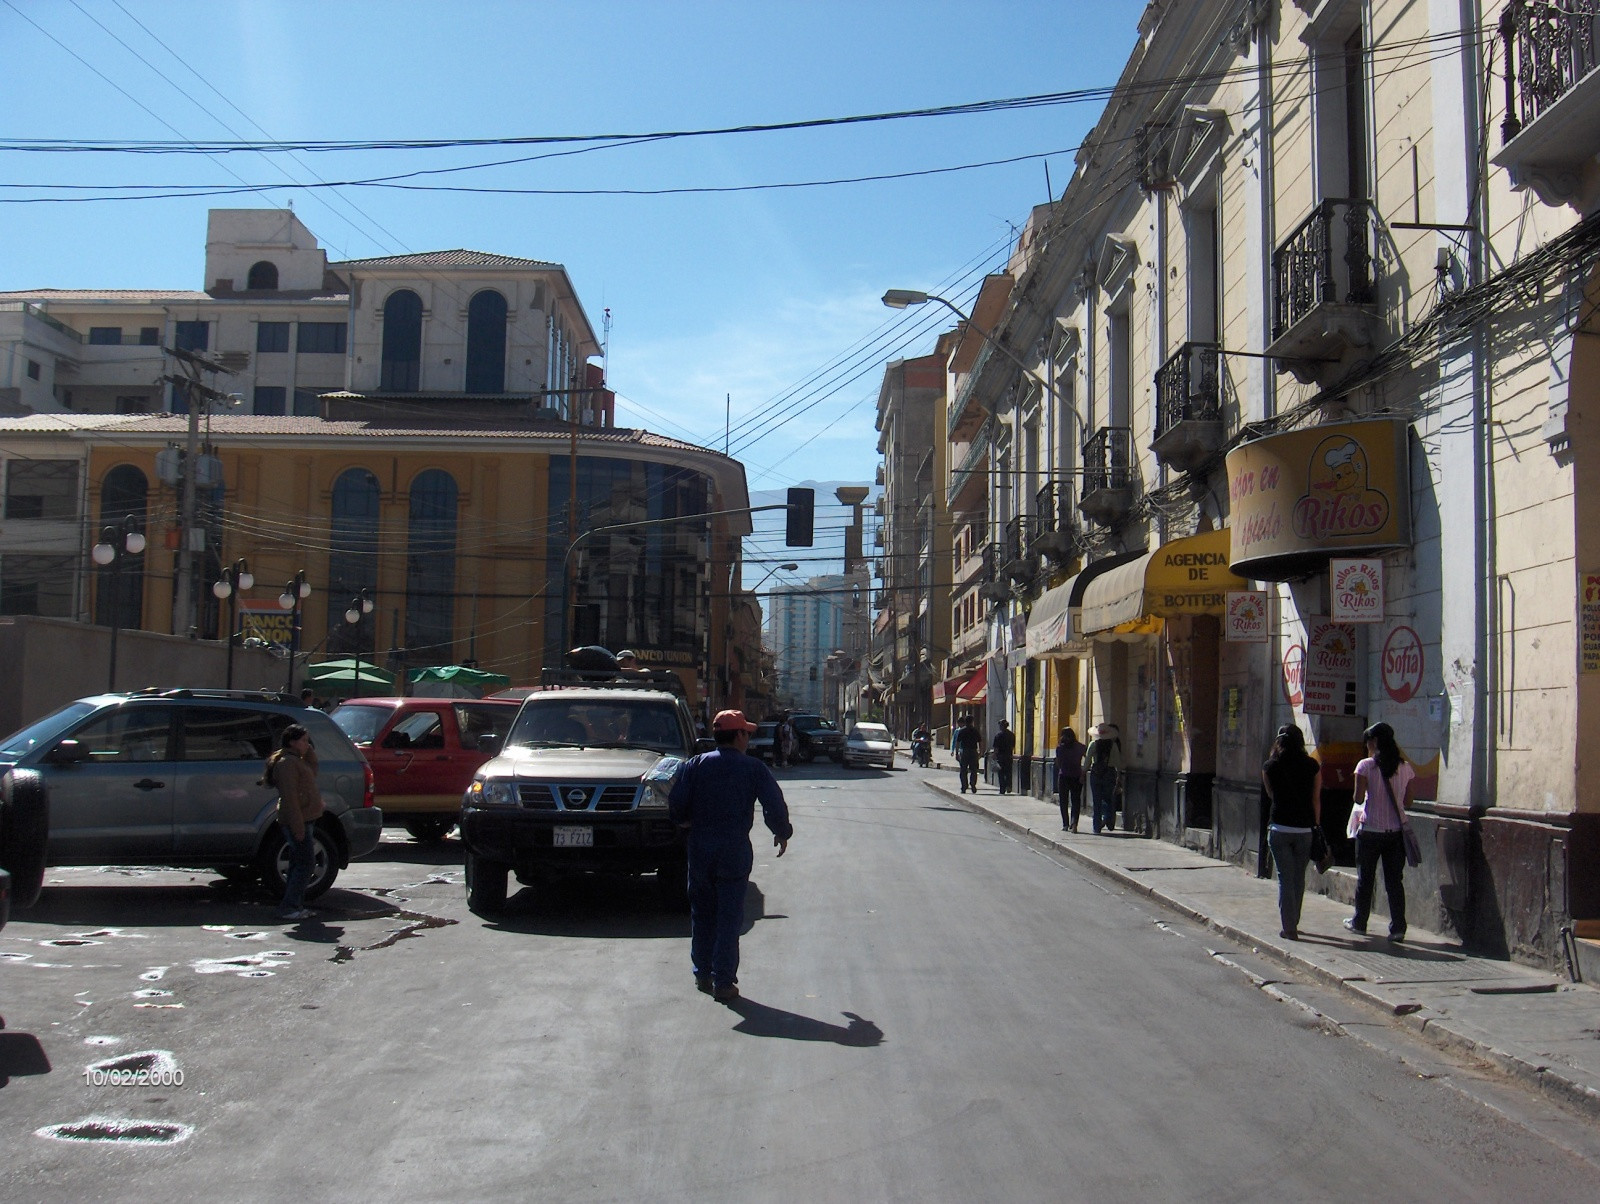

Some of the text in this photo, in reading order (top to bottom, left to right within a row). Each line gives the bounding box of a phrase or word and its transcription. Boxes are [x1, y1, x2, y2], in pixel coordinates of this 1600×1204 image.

[1259, 465, 1281, 492] en
[1297, 493, 1382, 540] Rikos
[1165, 552, 1227, 567] AGENCIA
[1188, 567, 1209, 580] DE
[1336, 564, 1380, 591] Pollos Rikos
[1249, 595, 1264, 617] Rikos
[1340, 592, 1376, 612] Rikos
[1232, 617, 1261, 634] Rikos
[632, 648, 663, 661] ANCO
[1316, 650, 1351, 671] Rikos
[1386, 641, 1418, 681] Sofía
[1306, 680, 1336, 689] ENTERO
[1306, 691, 1331, 700] MEDIO
[1305, 703, 1337, 713] CUARTO
